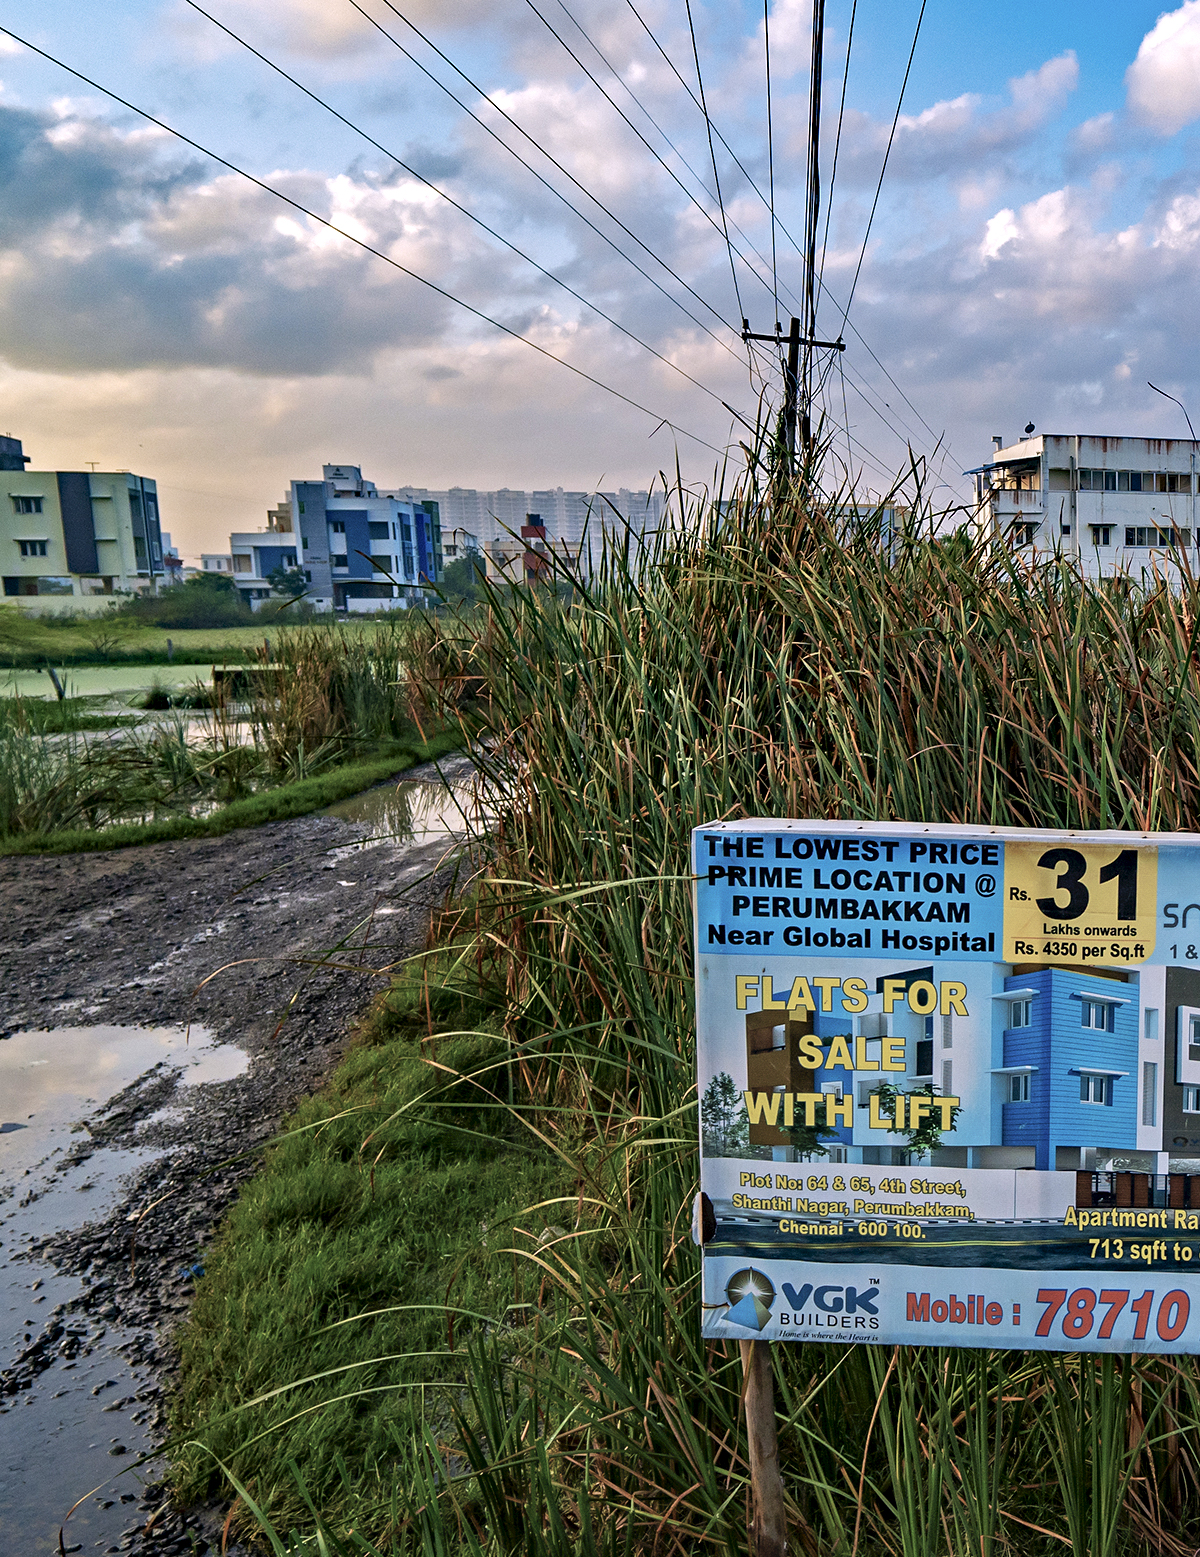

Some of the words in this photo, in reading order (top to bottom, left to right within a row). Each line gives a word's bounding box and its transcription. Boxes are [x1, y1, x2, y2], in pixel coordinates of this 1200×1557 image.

[703, 835, 764, 858] THE
[775, 838, 899, 862] LOWEST
[910, 842, 999, 866] PRICE
[708, 865, 802, 888] PRIME
[814, 868, 966, 894] LOCATION
[975, 874, 996, 897] @
[1009, 887, 1031, 901] Rs.
[1035, 848, 1138, 921] 31
[732, 895, 970, 923] PERUMBAKKAM
[708, 924, 774, 946] Near
[783, 926, 871, 949] Global
[881, 928, 995, 956] Hospital
[1043, 923, 1080, 935] Lakhs
[1084, 925, 1137, 936] onwards
[1015, 941, 1038, 955] Rs.
[1043, 942, 1077, 956] 4350
[1082, 945, 1106, 960] per
[1110, 943, 1145, 960] Sq.ft
[1170, 945, 1177, 959] 1
[1185, 945, 1198, 960] &
[735, 975, 868, 1013] FLATS
[883, 978, 969, 1016] FOR
[798, 1034, 907, 1072] SALE
[743, 1090, 853, 1128] WITH
[869, 1094, 960, 1131] LIFT
[740, 1172, 772, 1188] Plot
[776, 1174, 802, 1190] No:
[807, 1176, 827, 1191] 64
[833, 1176, 846, 1191] &
[850, 1176, 875, 1195] 65,
[879, 1178, 906, 1194] 4th
[910, 1179, 966, 1198] Street,
[732, 1193, 791, 1212] Shanthi
[796, 1198, 850, 1217] Nagar,
[854, 1199, 975, 1220] Perumbakkam,
[1064, 1206, 1168, 1231] Apartment
[779, 1219, 843, 1236] Chennai
[858, 1222, 888, 1237] 600
[893, 1224, 926, 1239] 100.
[1088, 1238, 1124, 1259] 713
[1130, 1240, 1167, 1265] sqft
[1173, 1242, 1193, 1261] to
[781, 1282, 880, 1315] VGK
[780, 1313, 879, 1329] BUILDERS
[906, 1292, 1003, 1325] Mobile
[1035, 1287, 1191, 1342] 78710
[779, 1330, 801, 1338] Home
[849, 1333, 871, 1341] Heart
